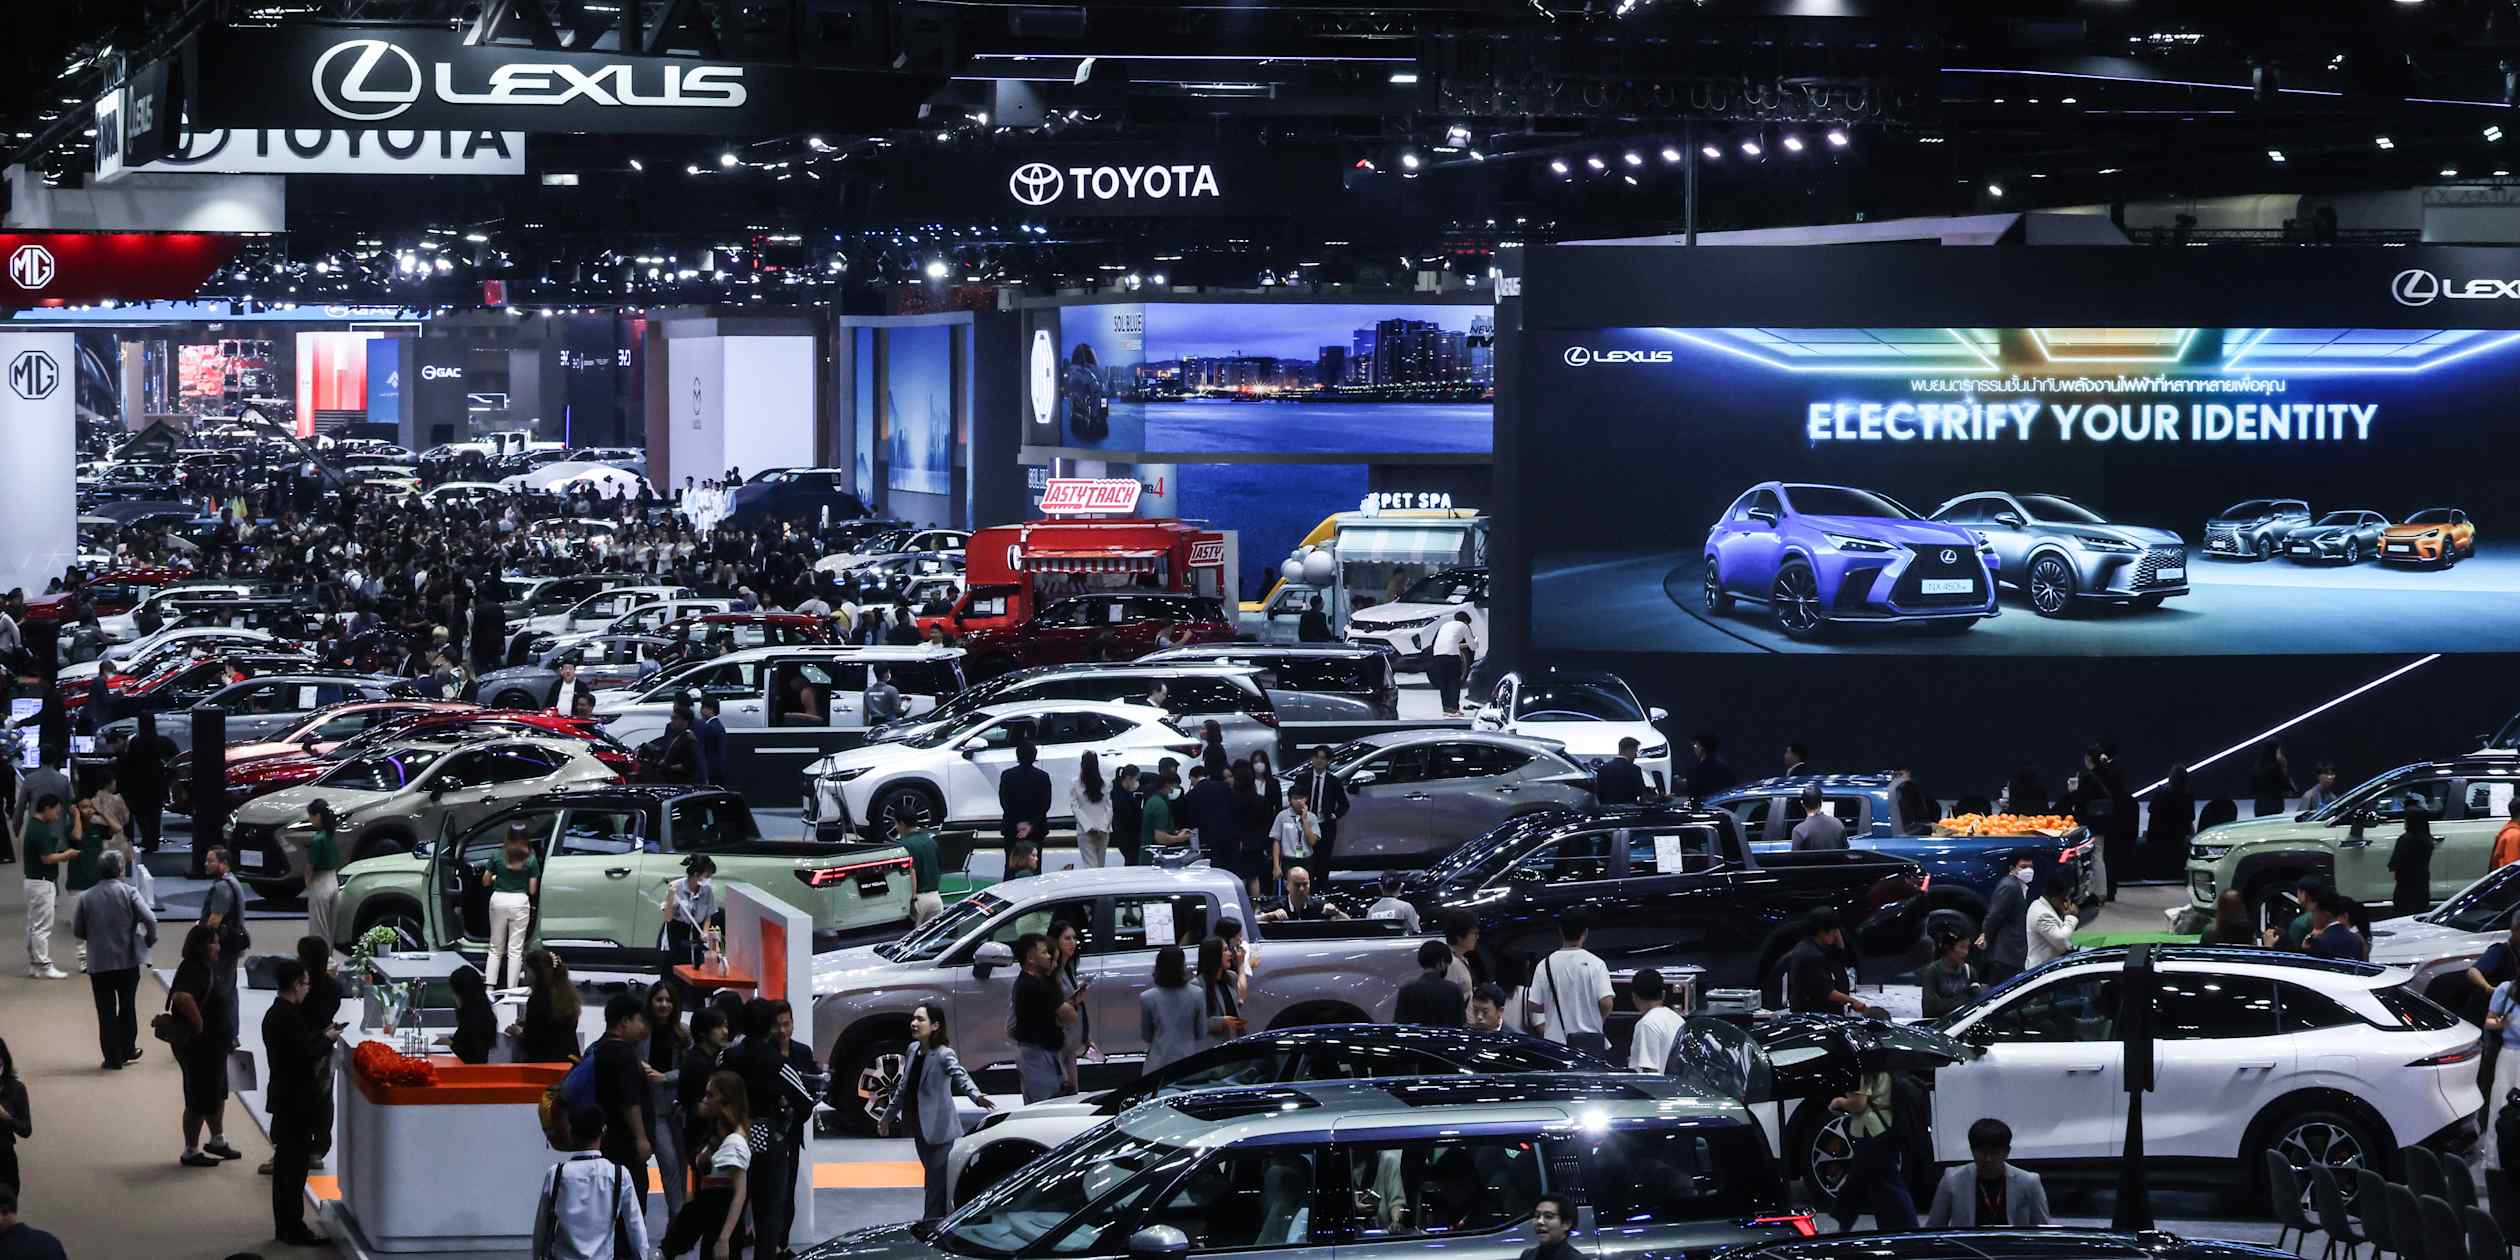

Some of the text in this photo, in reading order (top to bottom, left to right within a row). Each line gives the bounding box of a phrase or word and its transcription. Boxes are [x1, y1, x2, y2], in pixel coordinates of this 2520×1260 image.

[435, 63, 746, 107] LEXUS
[1070, 165, 1220, 199] TOYOTA
[13, 248, 51, 286] MG
[2442, 279, 2520, 299] LEX
[437, 368, 461, 378] GAC
[1592, 350, 1673, 363] LEXUS
[14, 355, 54, 395] MG
[1809, 403, 2378, 440] ELECTRIFY YOUR IDENTITY
[1380, 492, 1452, 509] PET SPA
